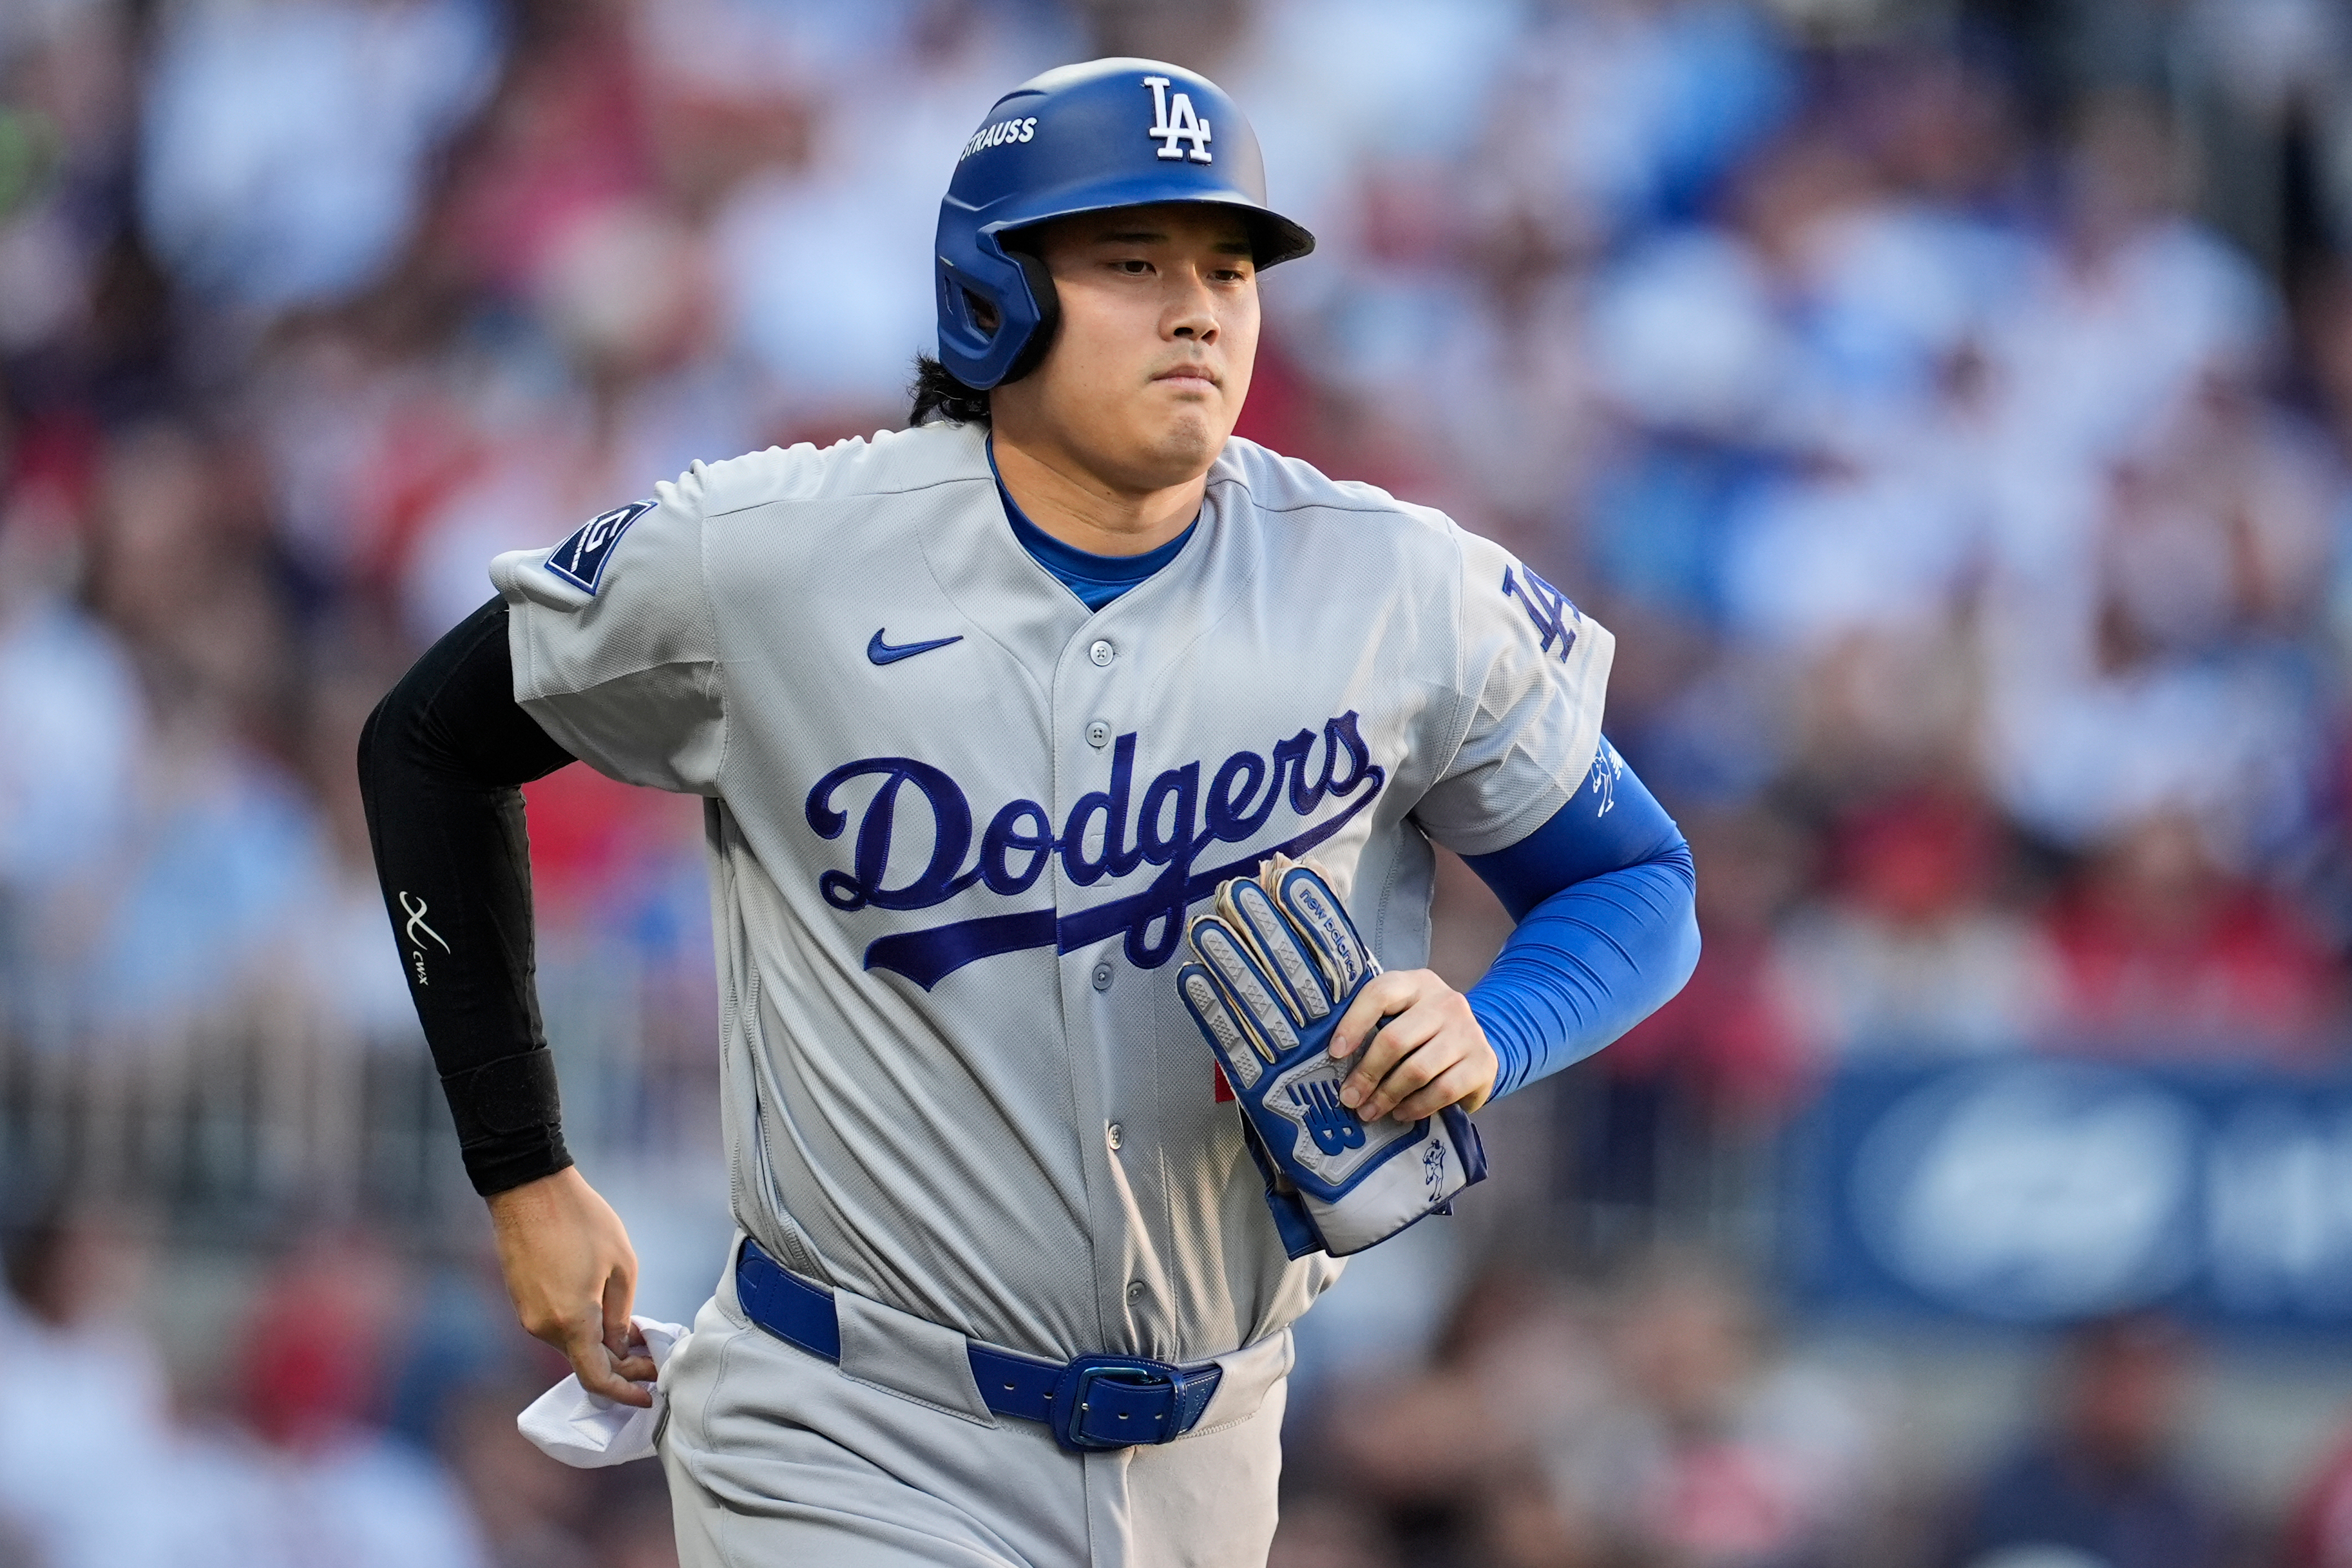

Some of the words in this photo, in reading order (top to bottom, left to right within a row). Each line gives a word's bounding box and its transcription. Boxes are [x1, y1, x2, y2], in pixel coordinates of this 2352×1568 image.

[1143, 77, 1212, 164] LA
[1502, 562, 1581, 664] LA
[805, 709, 1385, 970] Dodgers
[1299, 888, 1327, 920] new
[1323, 917, 1357, 982] balance
